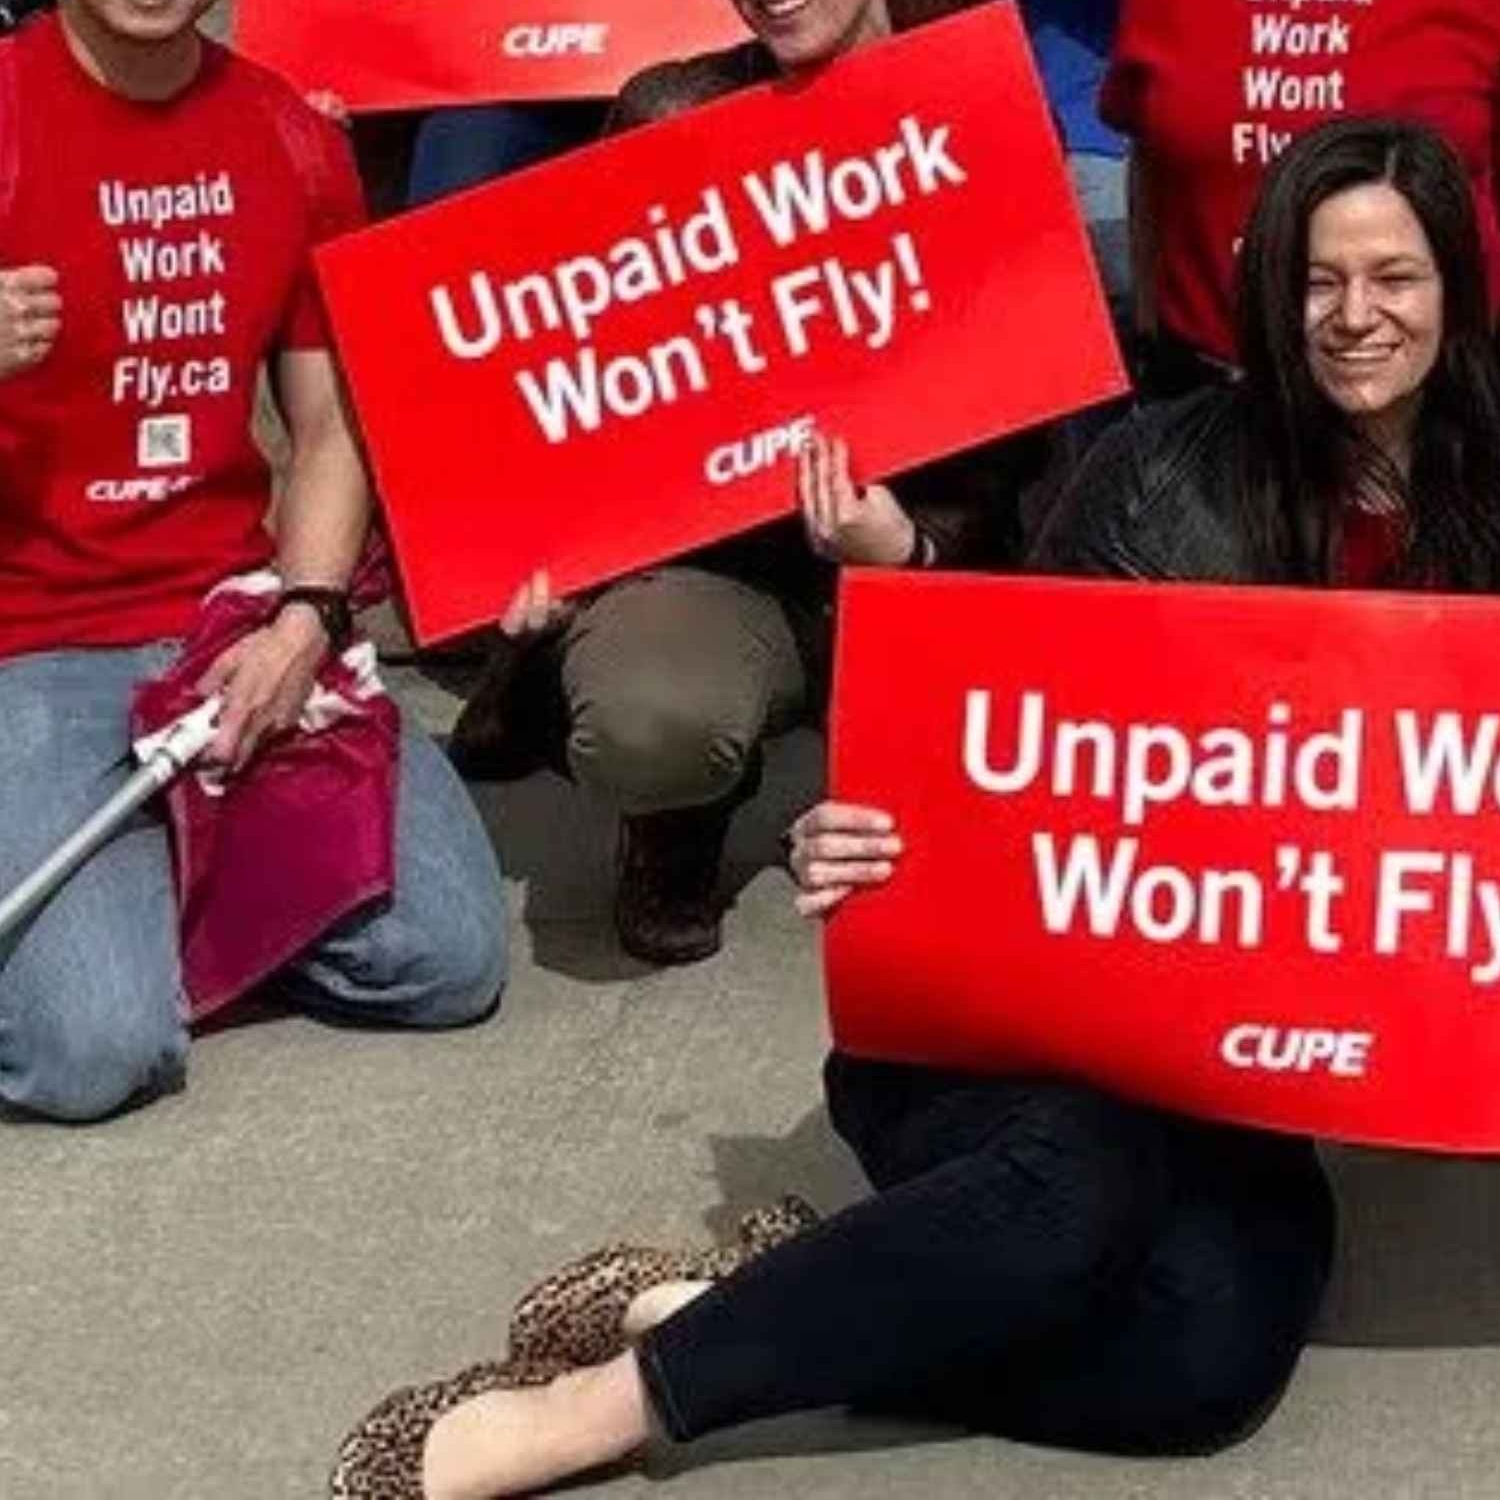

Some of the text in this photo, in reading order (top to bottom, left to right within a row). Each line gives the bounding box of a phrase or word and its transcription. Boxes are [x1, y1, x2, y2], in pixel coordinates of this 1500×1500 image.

[503, 23, 610, 58] CUPE
[1251, 14, 1351, 53] Work
[1242, 67, 1344, 110] Wont
[99, 172, 235, 230] Unpaid
[120, 230, 225, 283] Work
[430, 115, 968, 361] Unpaid Work
[123, 290, 225, 343] Wont
[516, 232, 931, 445] Won't Fly!
[112, 357, 230, 406] Fly.ca
[961, 688, 1361, 825] Unpaid
[1033, 832, 1343, 952] Won't
[1220, 1025, 1373, 1077] CUPE
